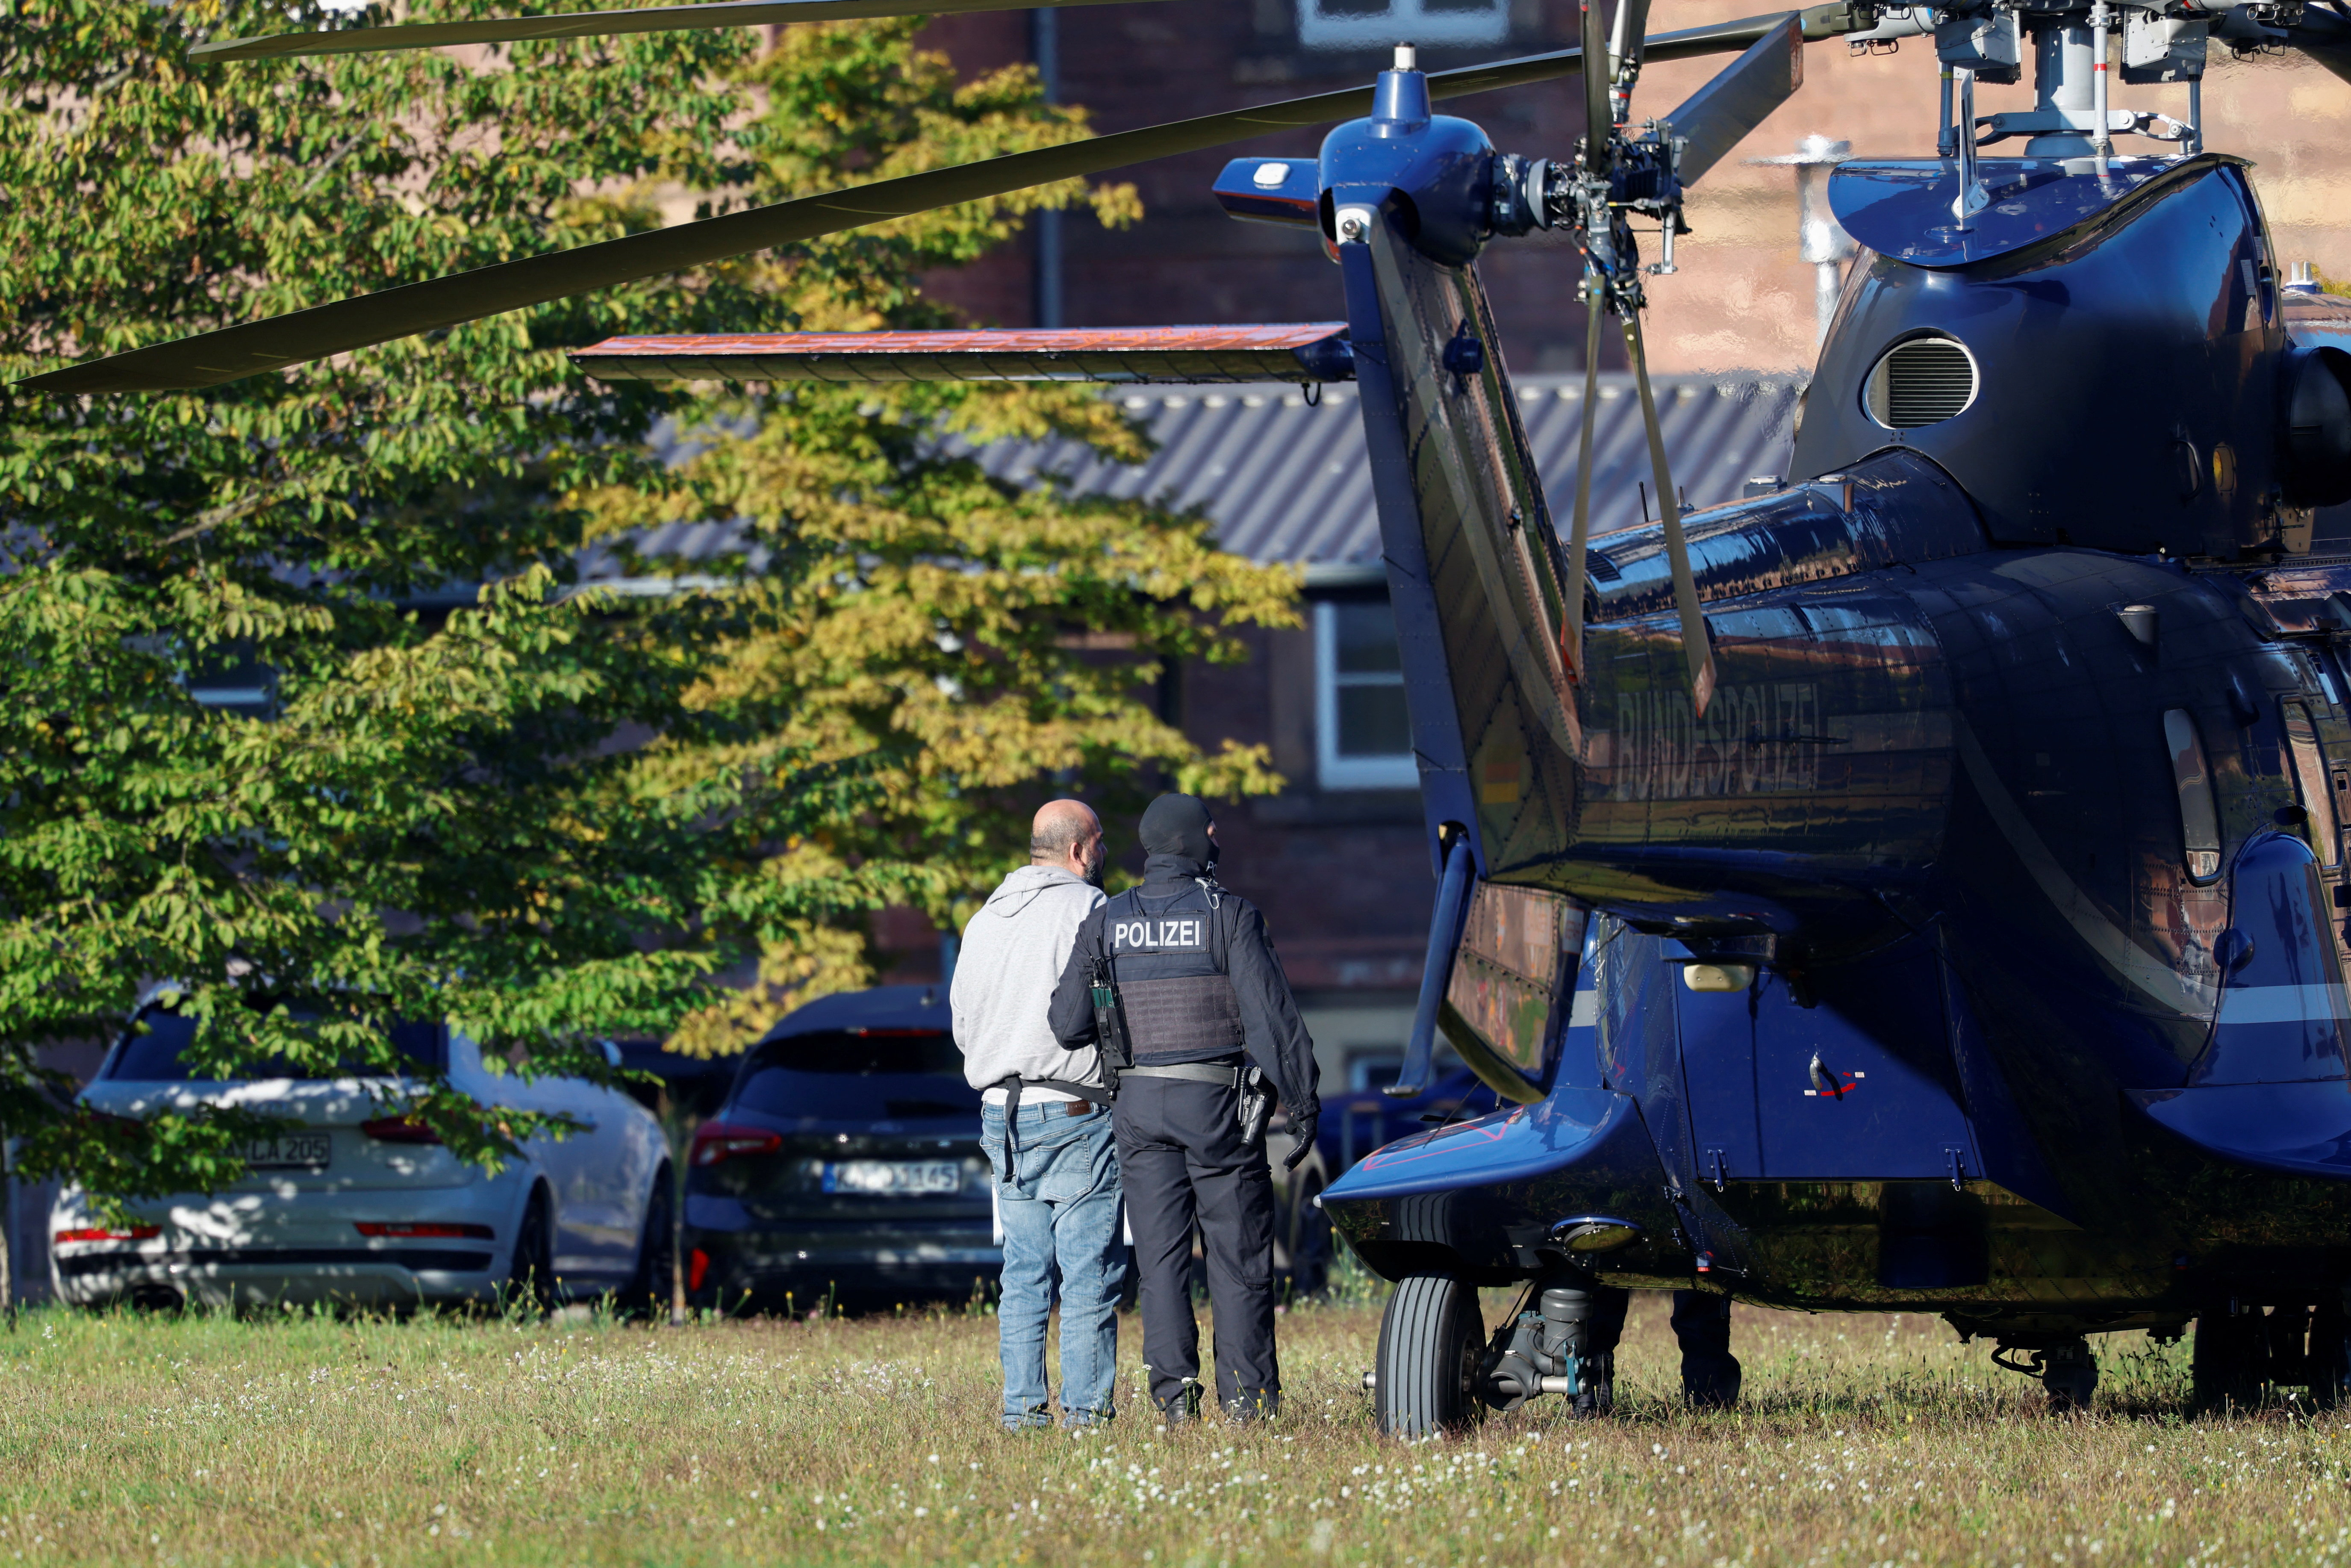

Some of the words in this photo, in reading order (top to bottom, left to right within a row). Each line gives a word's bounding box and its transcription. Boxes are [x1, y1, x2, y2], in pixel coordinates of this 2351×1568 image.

[1616, 683, 1818, 802] BUNDESPOLIZEI
[1115, 920, 1199, 948] POLIZEI
[286, 1139, 326, 1160] 205
